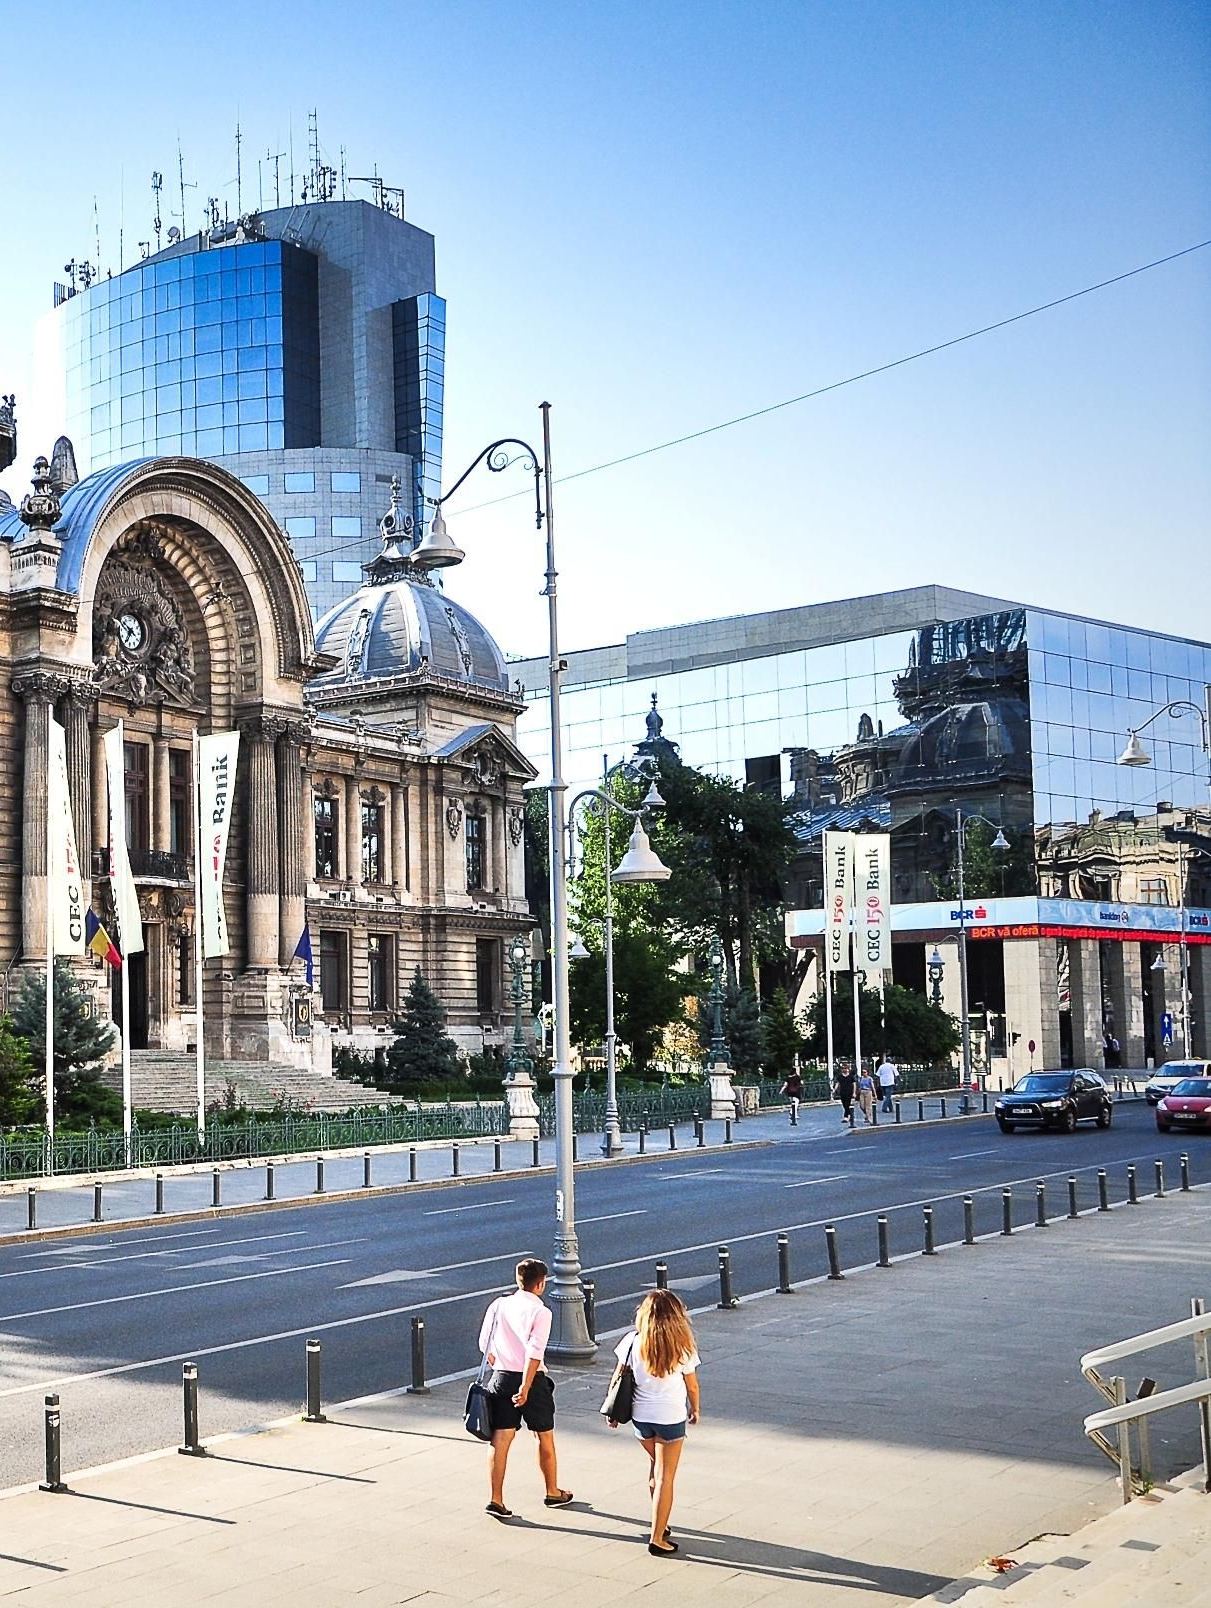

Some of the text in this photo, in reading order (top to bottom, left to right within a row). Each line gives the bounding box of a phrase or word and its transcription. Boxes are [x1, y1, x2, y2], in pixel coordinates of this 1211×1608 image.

[68, 885, 82, 943] CEC
[832, 845, 846, 963] CEC 150 Bank
[865, 848, 884, 962] CEC 150 Bank
[950, 909, 974, 921] BCR
[972, 927, 996, 938] BCR
[997, 926, 1010, 937] vă
[1012, 925, 1039, 936] oferă
